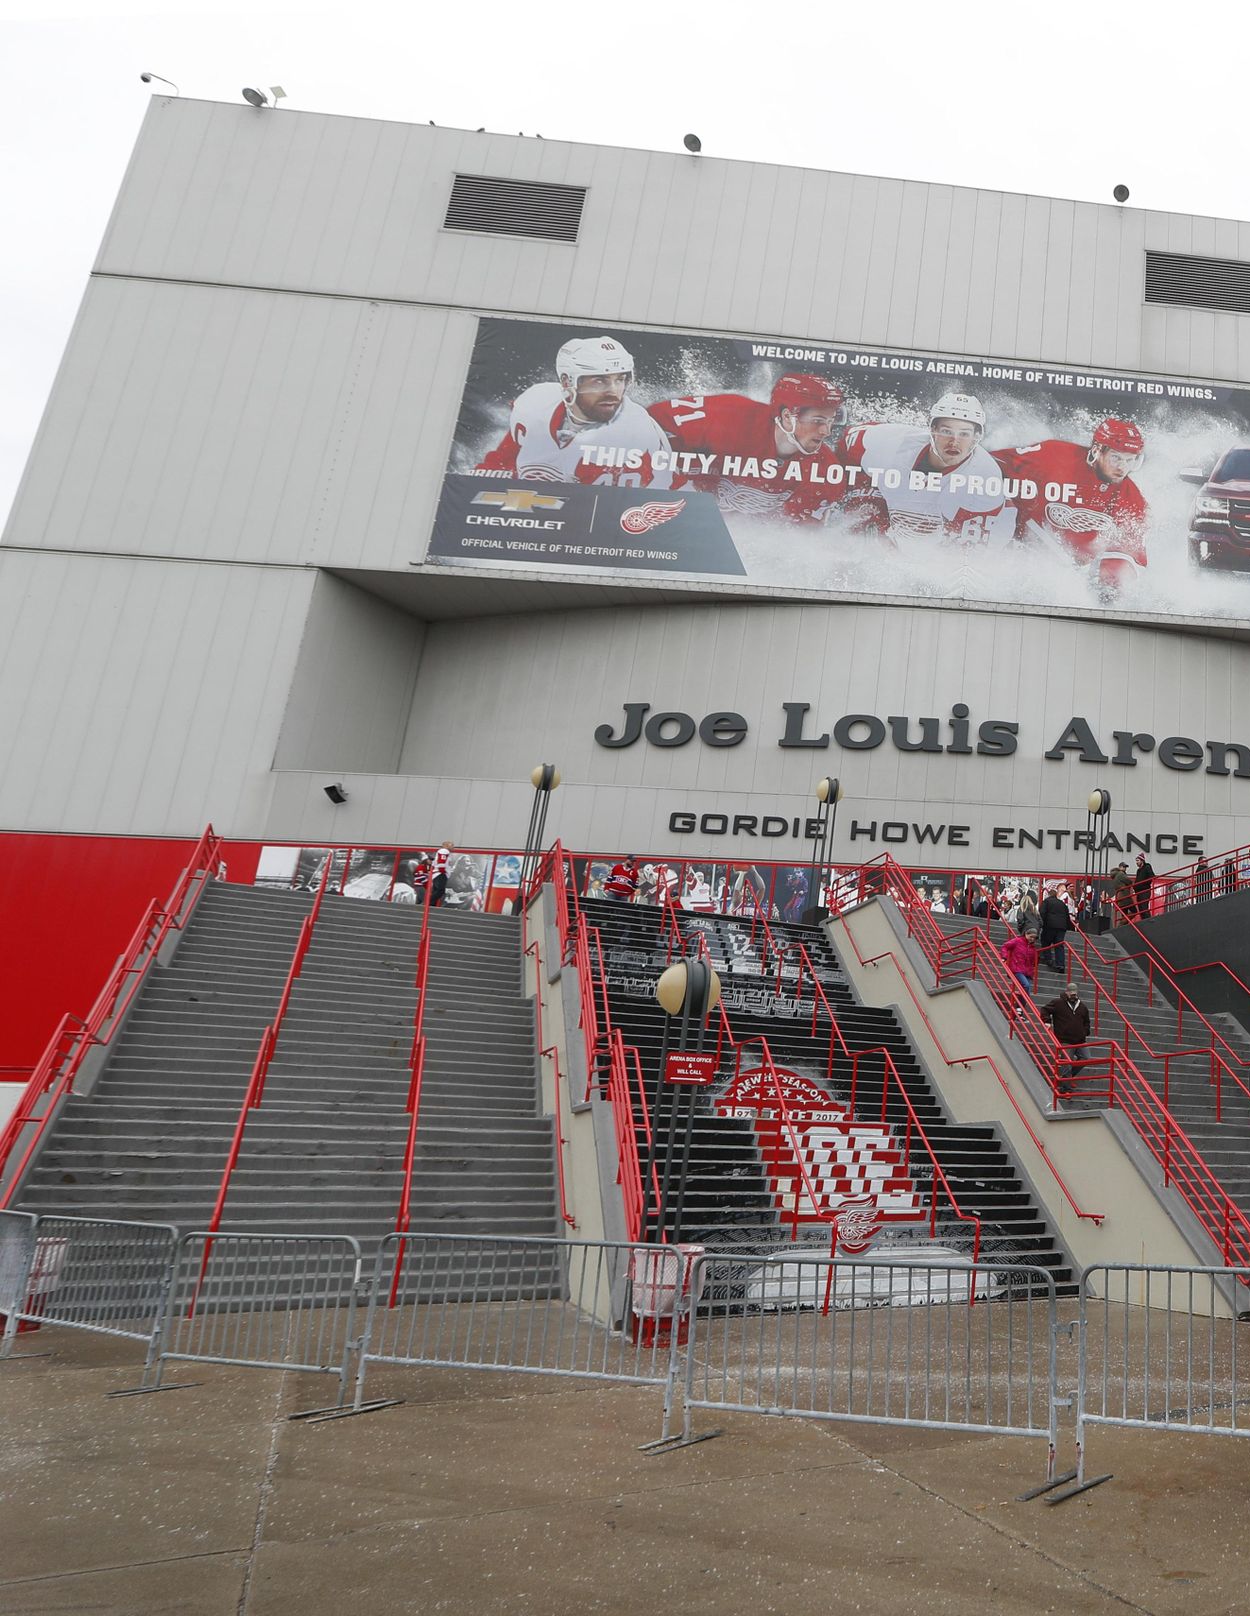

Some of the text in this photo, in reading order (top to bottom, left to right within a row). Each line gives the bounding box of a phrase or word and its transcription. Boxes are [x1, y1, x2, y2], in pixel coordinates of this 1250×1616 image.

[751, 344, 1217, 400] WELCOME TO JOE LOUIS ARENA. HOME OF THE DETROIT RED WINGS.
[579, 445, 1083, 504] THIS CITY HAS A LOT TO BE PROUD OF.
[465, 514, 565, 531] CHEVROLET
[461, 538, 678, 561] OFFICIAL VEHICLE OF THE DETROIT RED WINGS
[594, 702, 748, 749] Joe
[778, 702, 1020, 756] Louis
[669, 812, 1204, 855] GORDIE HOWE ENTRANCE
[815, 1113, 839, 1121] 2017
